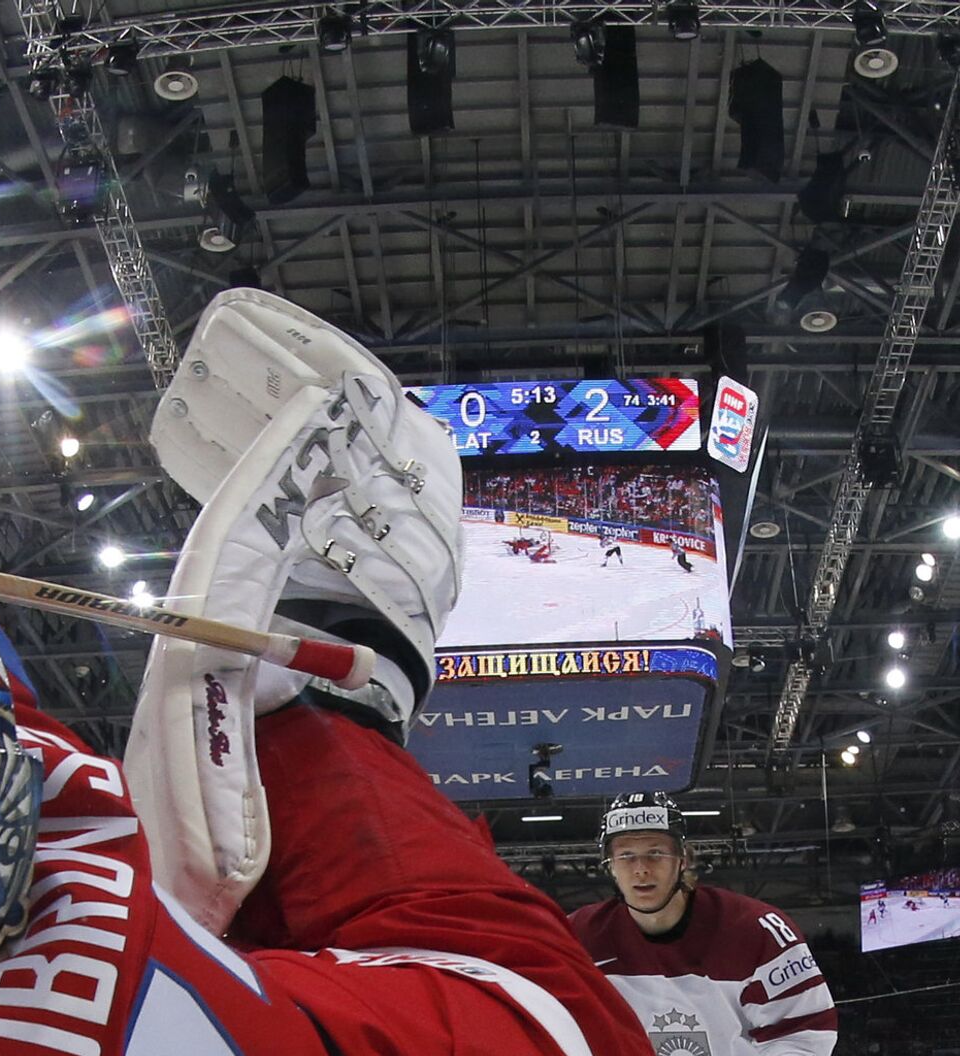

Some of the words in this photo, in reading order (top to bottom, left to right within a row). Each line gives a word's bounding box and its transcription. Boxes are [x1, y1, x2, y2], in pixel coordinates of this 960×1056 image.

[511, 386, 557, 405] 5:13
[623, 395, 640, 406] 74
[647, 394, 676, 406] 3:41
[460, 391, 486, 428] 0
[584, 387, 610, 423] 2
[454, 432, 492, 450] LAT
[530, 431, 540, 444] 2
[578, 429, 623, 445] RUS
[569, 521, 598, 533] zepter
[602, 526, 638, 539] zepter
[582, 704, 692, 721] ПАРК
[607, 810, 665, 828] Grindex
[758, 912, 798, 949] 18
